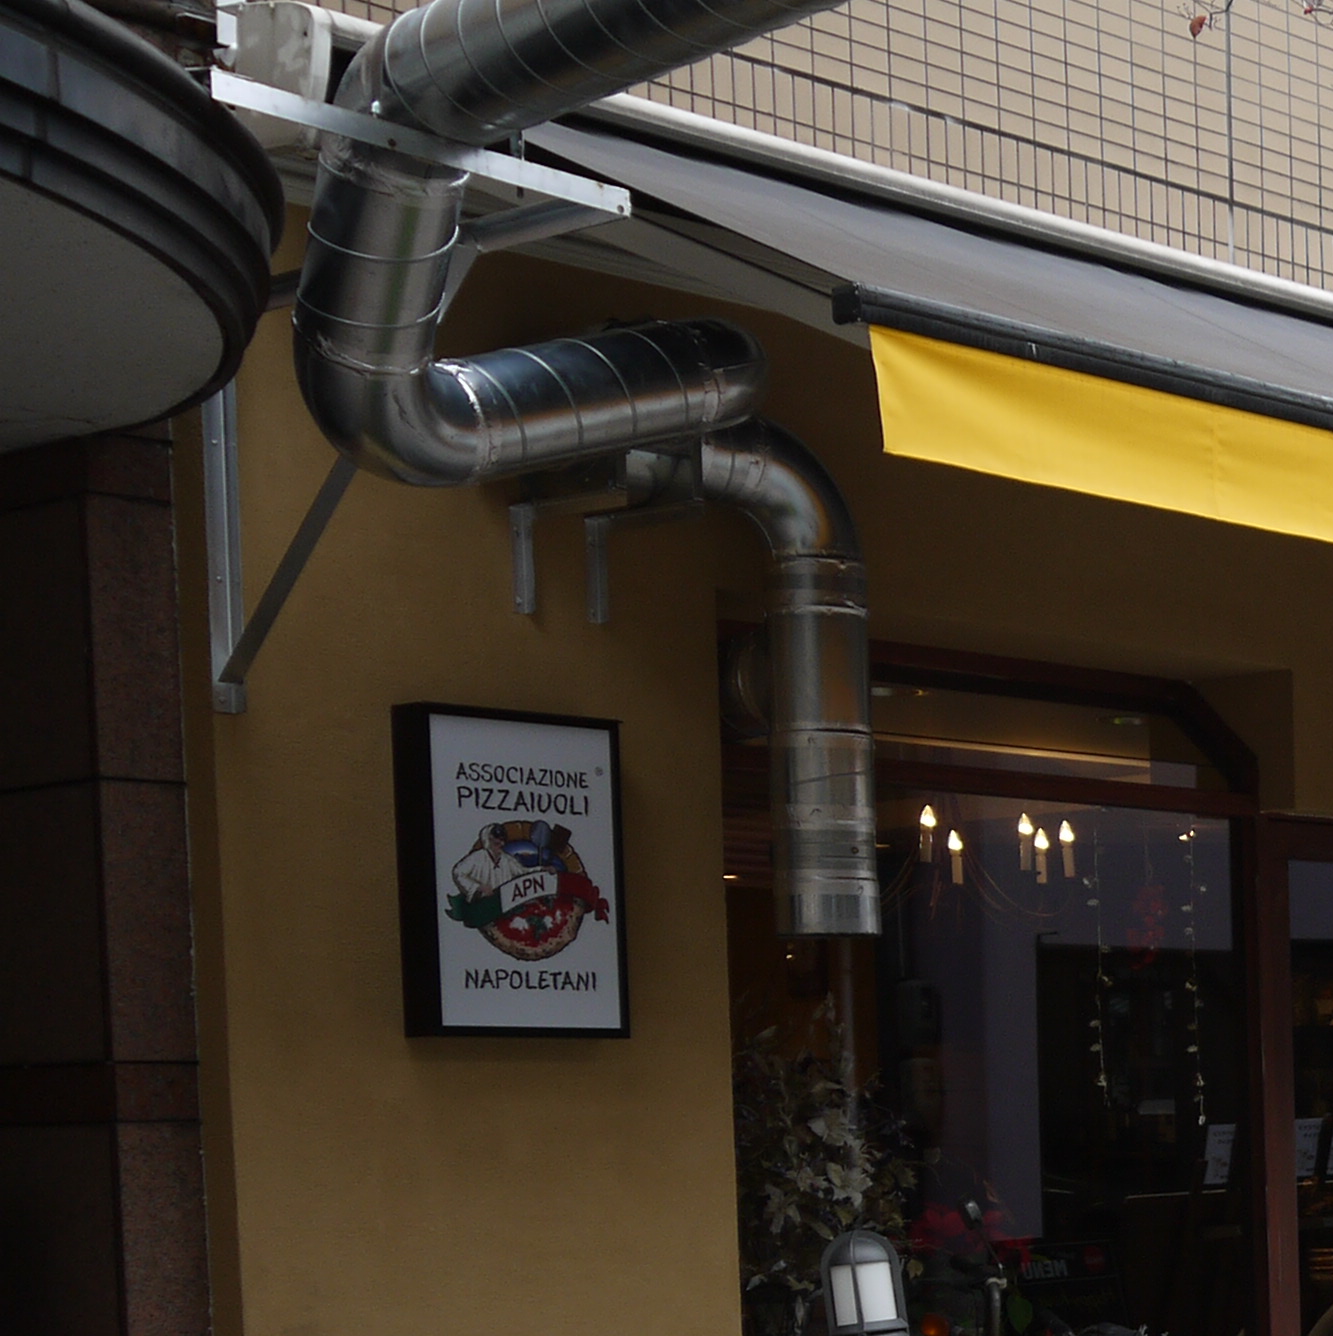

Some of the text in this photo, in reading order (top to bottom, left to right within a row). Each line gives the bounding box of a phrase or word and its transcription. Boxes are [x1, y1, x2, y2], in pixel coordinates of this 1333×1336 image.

[455, 762, 589, 789] ASSOCIAZIONE
[457, 786, 590, 817] PIZZAIUOLI
[511, 874, 545, 902] APN
[465, 969, 597, 992] NAPOLETANI
